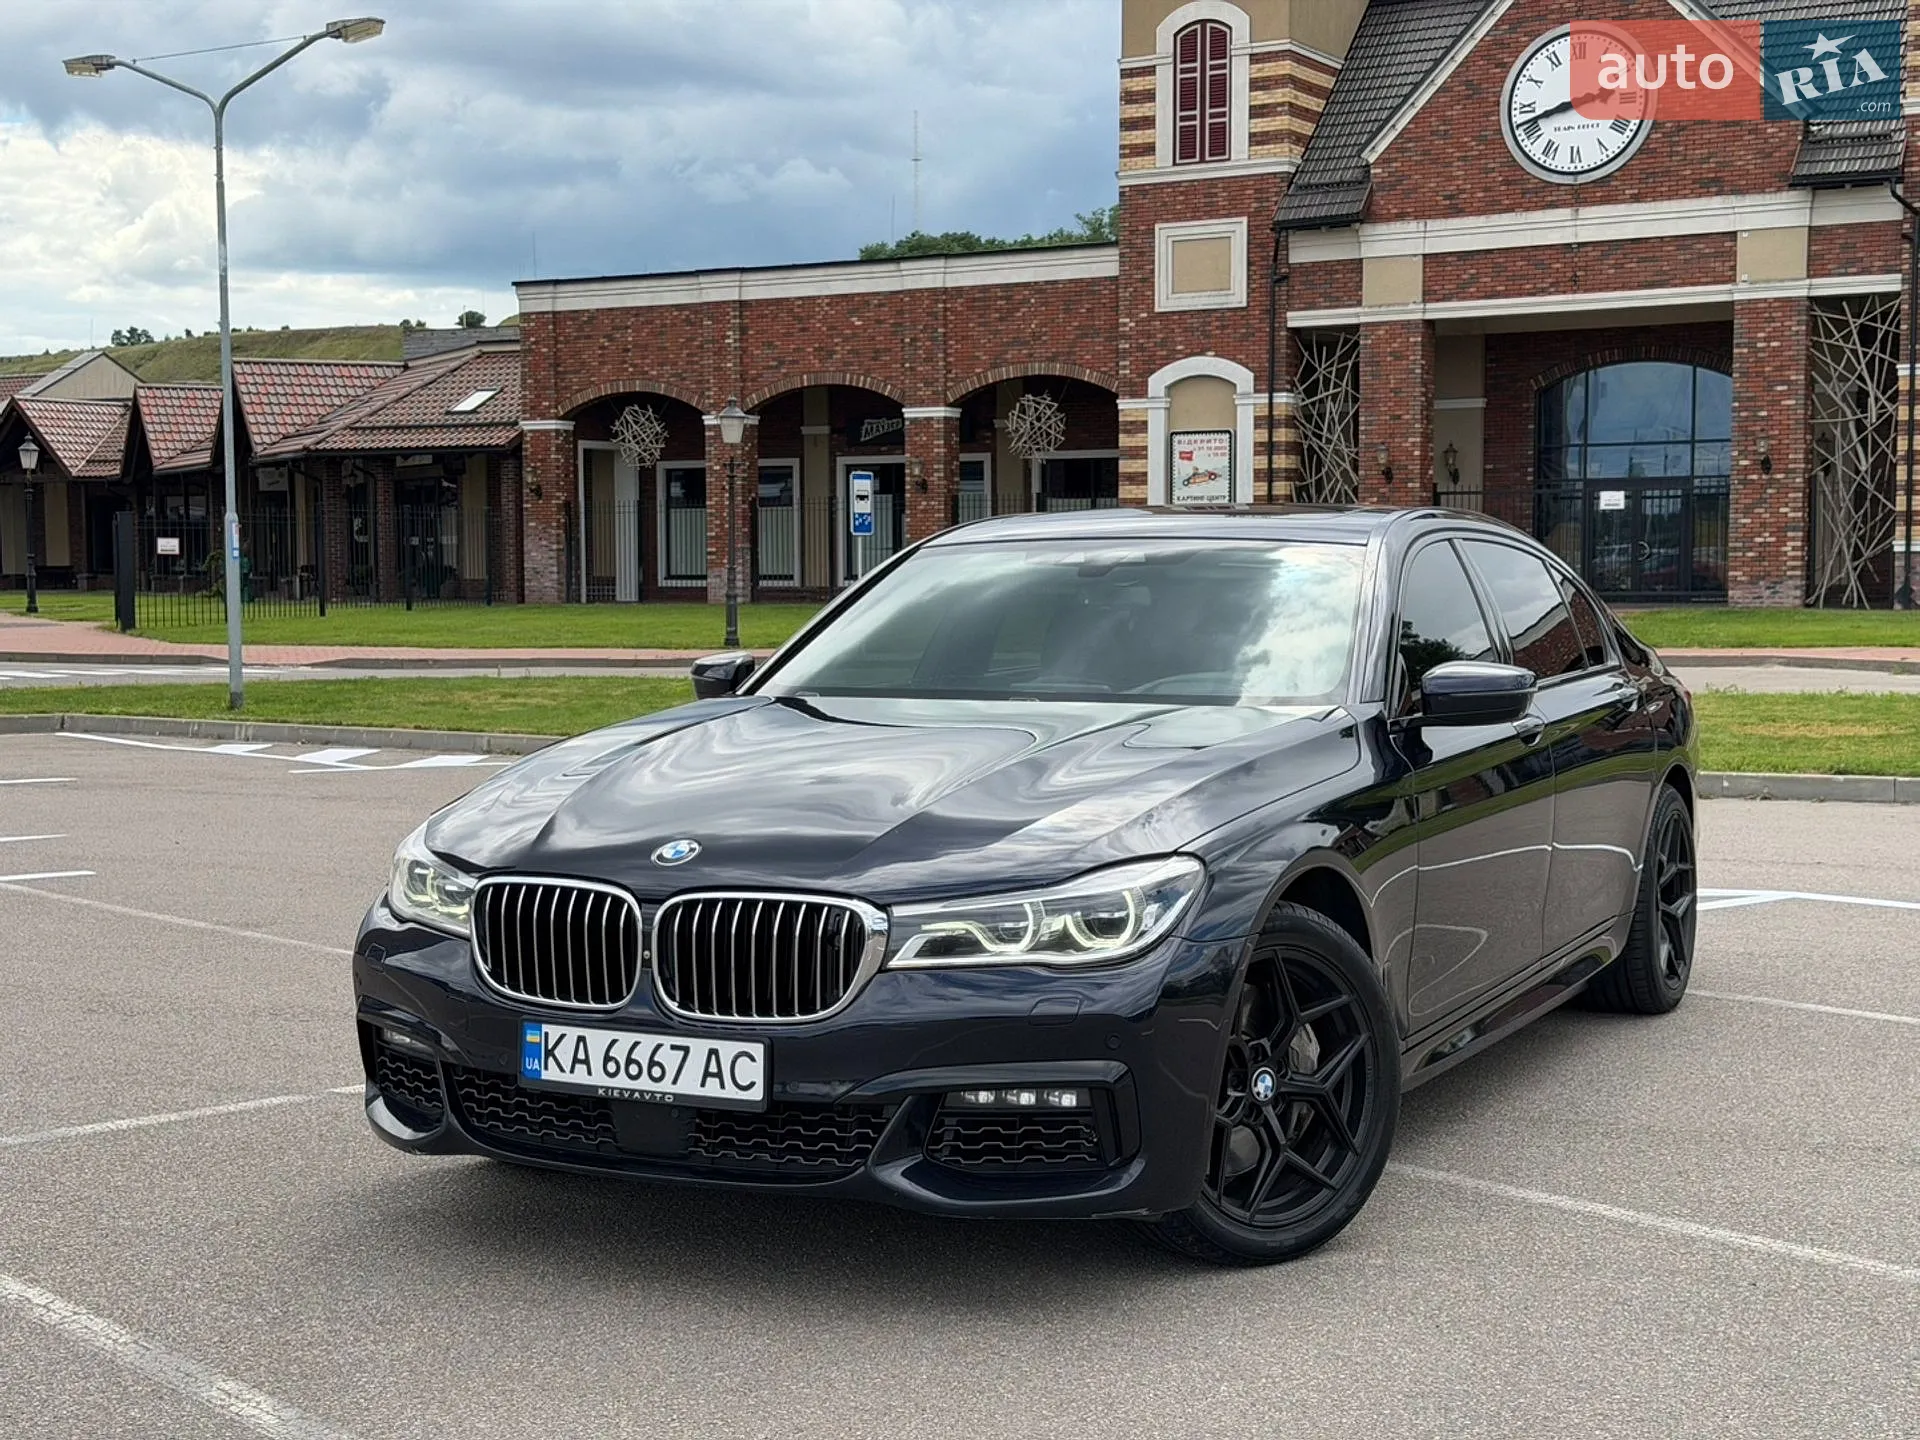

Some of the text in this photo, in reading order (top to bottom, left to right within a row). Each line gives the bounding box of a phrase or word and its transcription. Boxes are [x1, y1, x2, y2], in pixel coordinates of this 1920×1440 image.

[525, 1056, 540, 1071] UA
[543, 1031, 758, 1092] KA 6667 AC
[598, 1088, 674, 1102] KIEVAVTO
